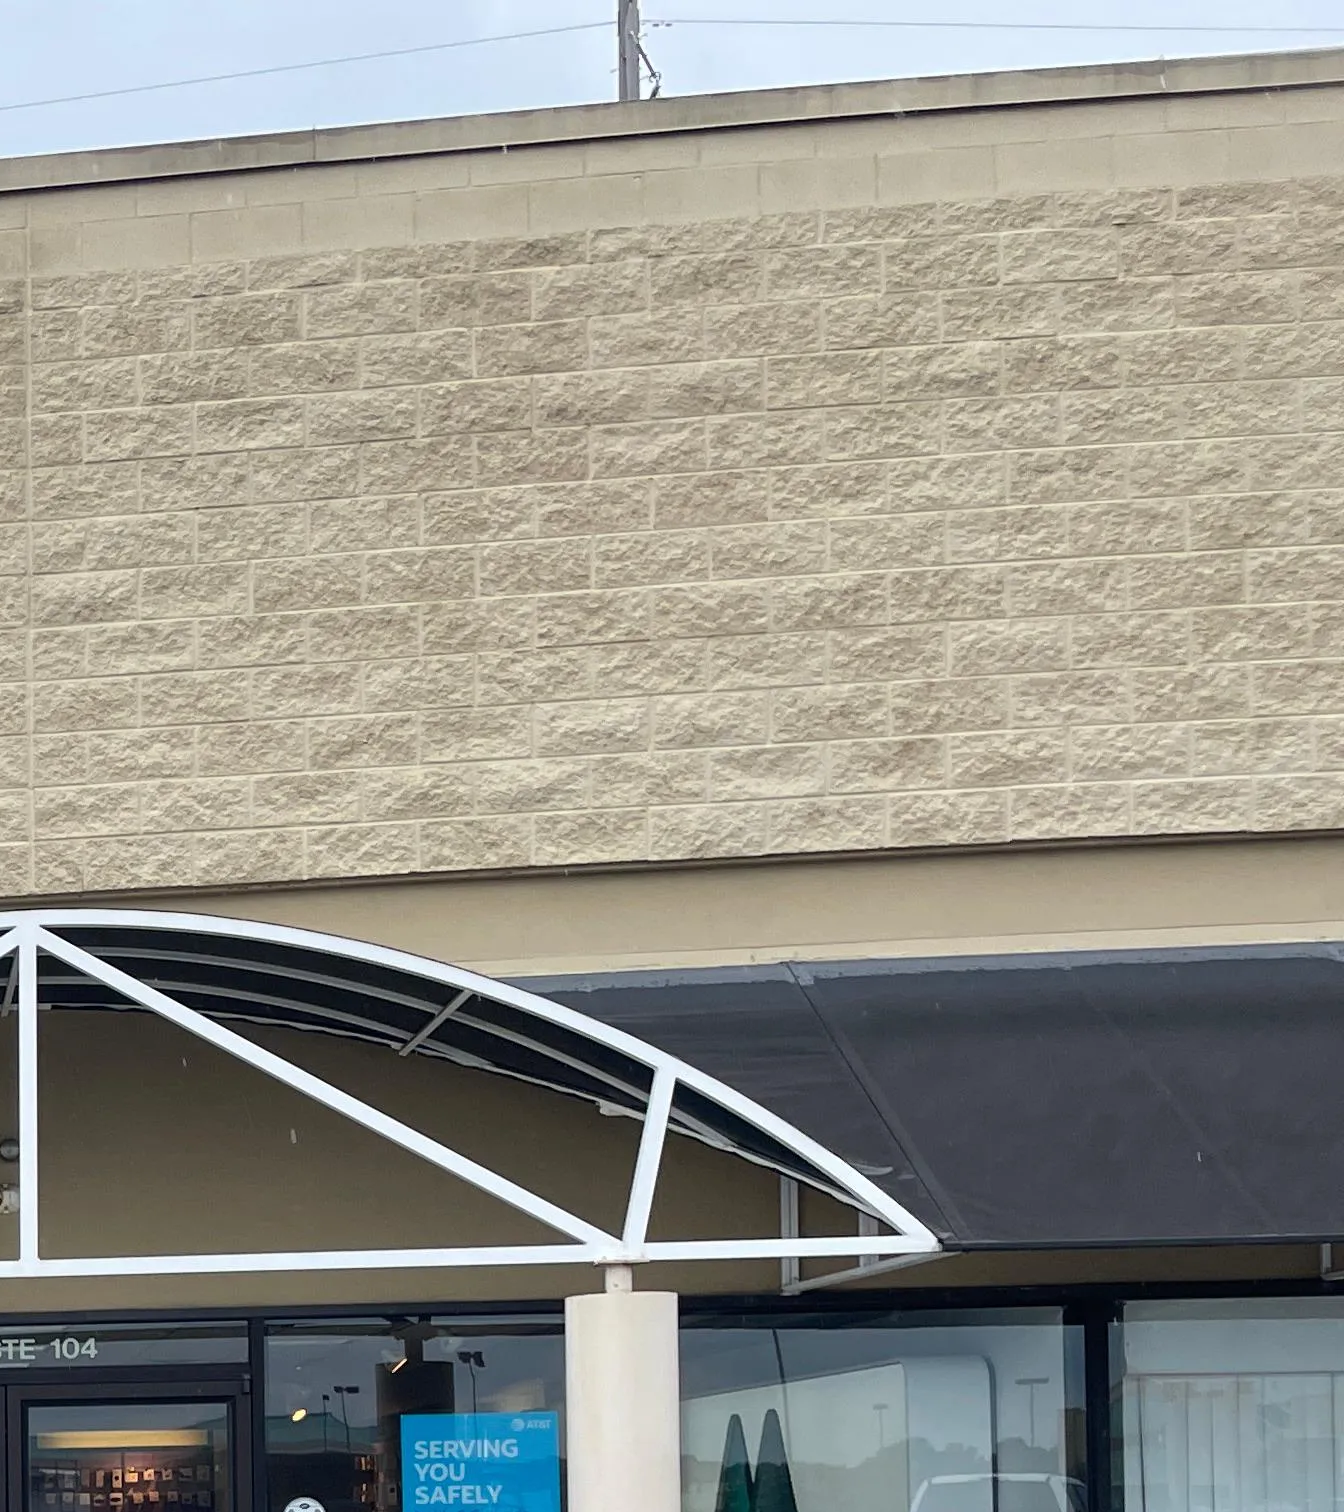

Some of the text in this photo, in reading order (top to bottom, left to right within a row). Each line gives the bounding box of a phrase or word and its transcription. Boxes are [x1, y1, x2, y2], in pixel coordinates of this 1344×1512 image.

[50, 1337, 98, 1360] 104
[526, 1419, 552, 1430] AT&T
[414, 1438, 519, 1459] SERVING
[414, 1463, 465, 1482] YOU
[415, 1485, 503, 1505] SAFELY
